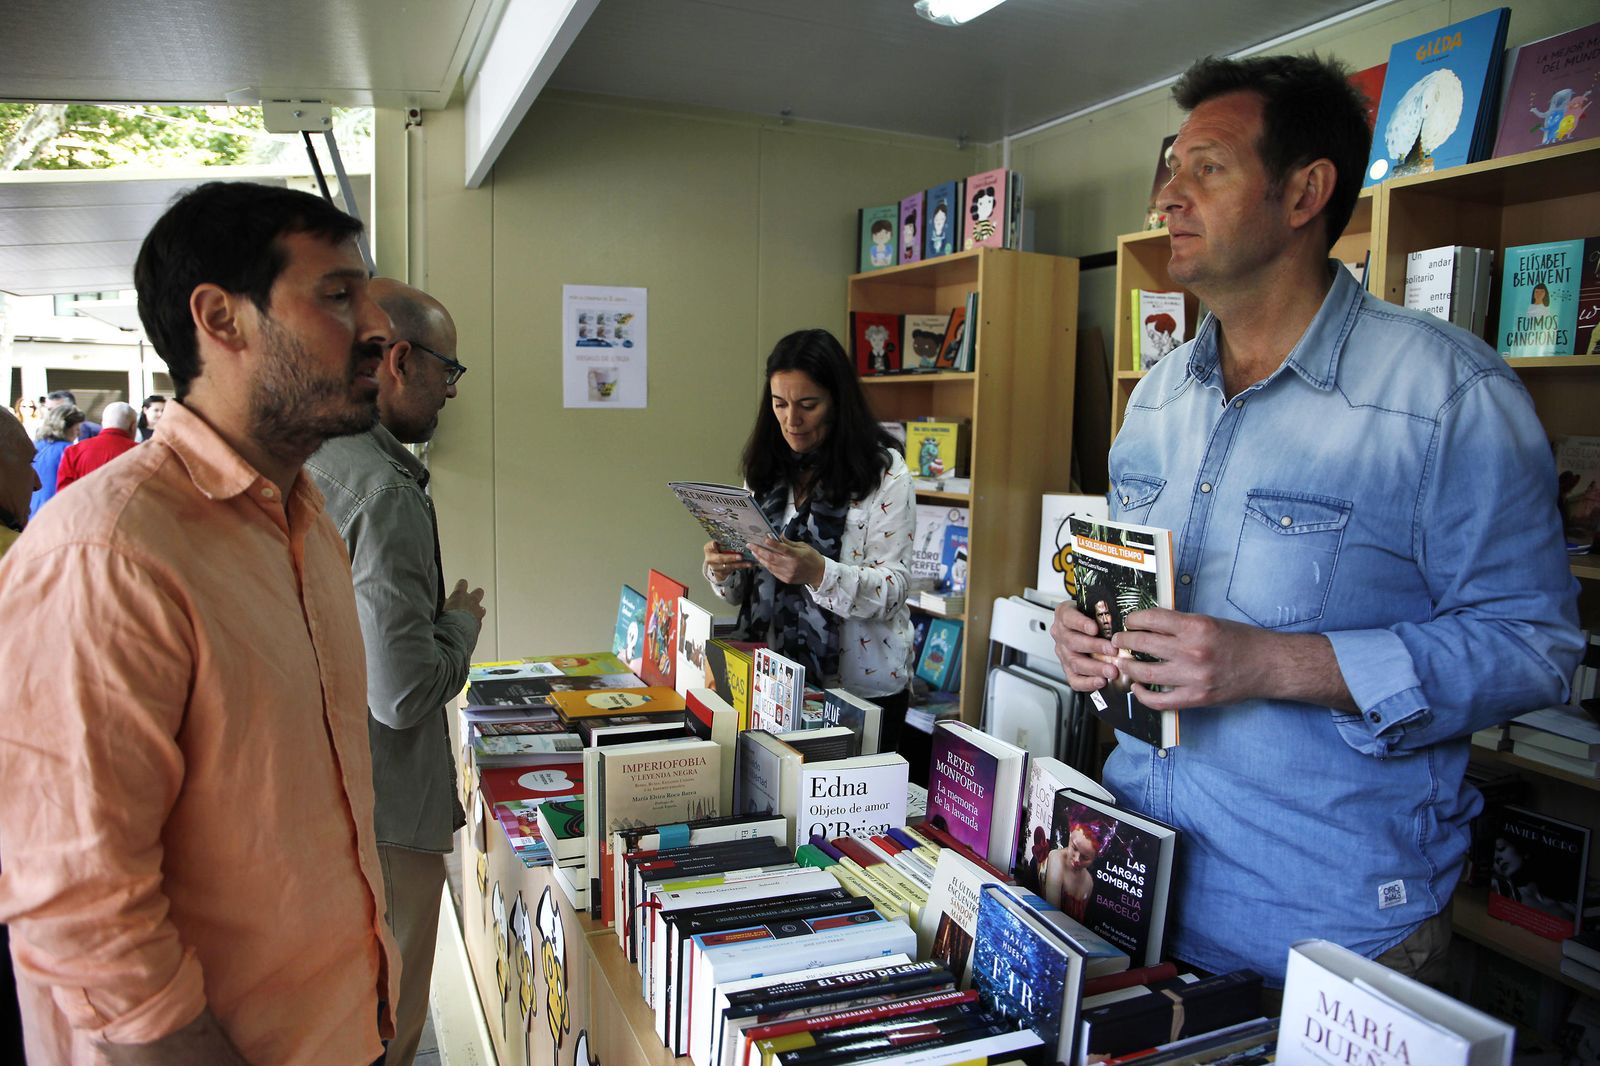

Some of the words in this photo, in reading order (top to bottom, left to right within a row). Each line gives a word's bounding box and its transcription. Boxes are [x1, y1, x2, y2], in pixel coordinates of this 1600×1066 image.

[1416, 32, 1463, 61] GILDA
[1564, 48, 1600, 68] MUND
[1411, 252, 1422, 261] Un
[1428, 258, 1452, 269] andar
[1405, 273, 1435, 284] solitario
[1513, 267, 1572, 287] BENAVENT
[1430, 292, 1451, 301] entre
[1517, 315, 1559, 332] FUIMOS
[1506, 330, 1568, 347] CANCIONES
[1078, 537, 1086, 546] LA
[1085, 539, 1108, 553] SOLEDAD
[1107, 546, 1119, 556] DEL
[1118, 548, 1142, 561] TIEMPO
[824, 701, 840, 725] BLUE
[622, 756, 706, 773] IMPERIOFOBIA
[637, 771, 671, 781] LEYENDA
[673, 769, 698, 777] NEGRA
[947, 751, 975, 777] REYES
[810, 776, 868, 798] Edna
[936, 759, 985, 799] MONFORTE
[937, 780, 946, 795] La
[947, 789, 979, 816] memoria
[1035, 783, 1050, 807] LOS
[809, 804, 846, 818] Objeto
[849, 802, 862, 813] de
[864, 801, 890, 812] amor
[934, 794, 943, 807] de
[943, 798, 950, 812] la
[952, 803, 979, 832] lavanda
[1504, 823, 1538, 841] JAVIER
[1542, 835, 1578, 853] MORO
[1106, 861, 1145, 886] LARGAS
[1127, 858, 1146, 874] LAS
[951, 876, 959, 886] EL
[1096, 869, 1143, 898] SOMBRAS
[1096, 894, 1140, 922] BARCELÓ
[1121, 894, 1141, 910] ELIA
[1002, 941, 1028, 968] HUERTA
[817, 978, 836, 988] EL
[836, 969, 877, 983] TREN
[877, 966, 897, 977] DE
[897, 960, 938, 974] LENIN
[806, 1015, 833, 1025] HARUKI
[834, 1008, 873, 1020] MURAKAMI
[878, 1003, 888, 1012] LA
[888, 1000, 909, 1010] CHICA
[910, 997, 923, 1005] DEL
[1317, 990, 1410, 1066] MARÍA
